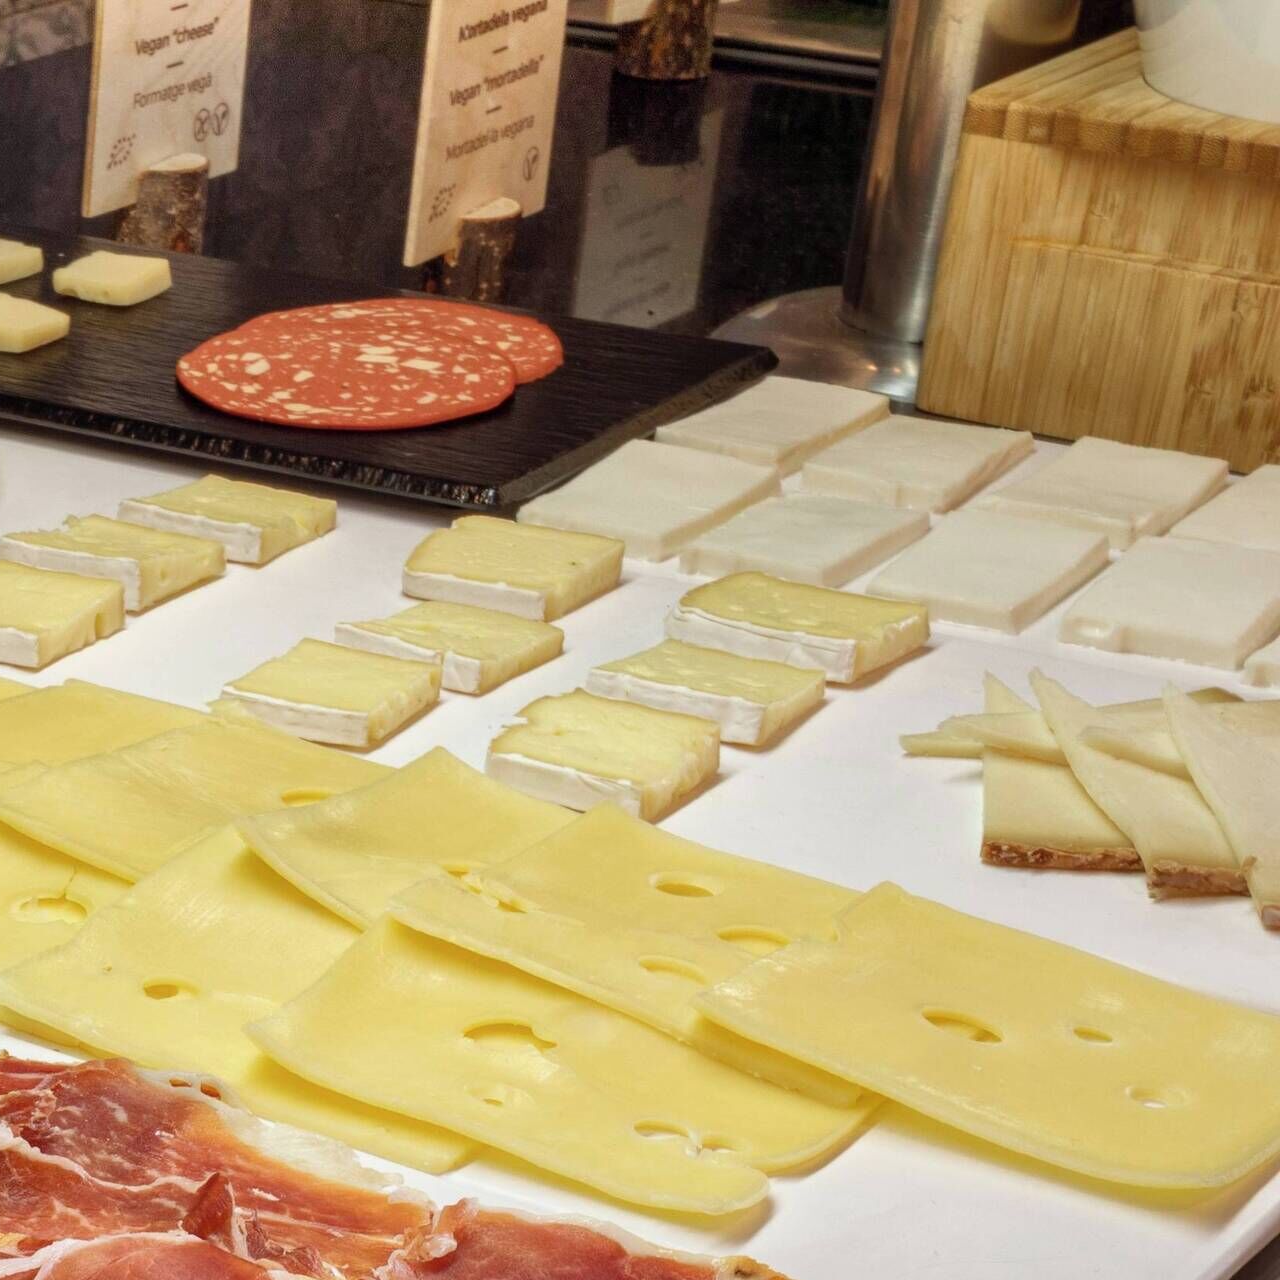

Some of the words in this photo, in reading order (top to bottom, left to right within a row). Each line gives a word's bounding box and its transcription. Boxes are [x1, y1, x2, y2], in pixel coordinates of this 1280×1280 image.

[135, 36, 170, 56] Vegan
[133, 83, 185, 109] Formatge
[450, 83, 481, 106] Vegan
